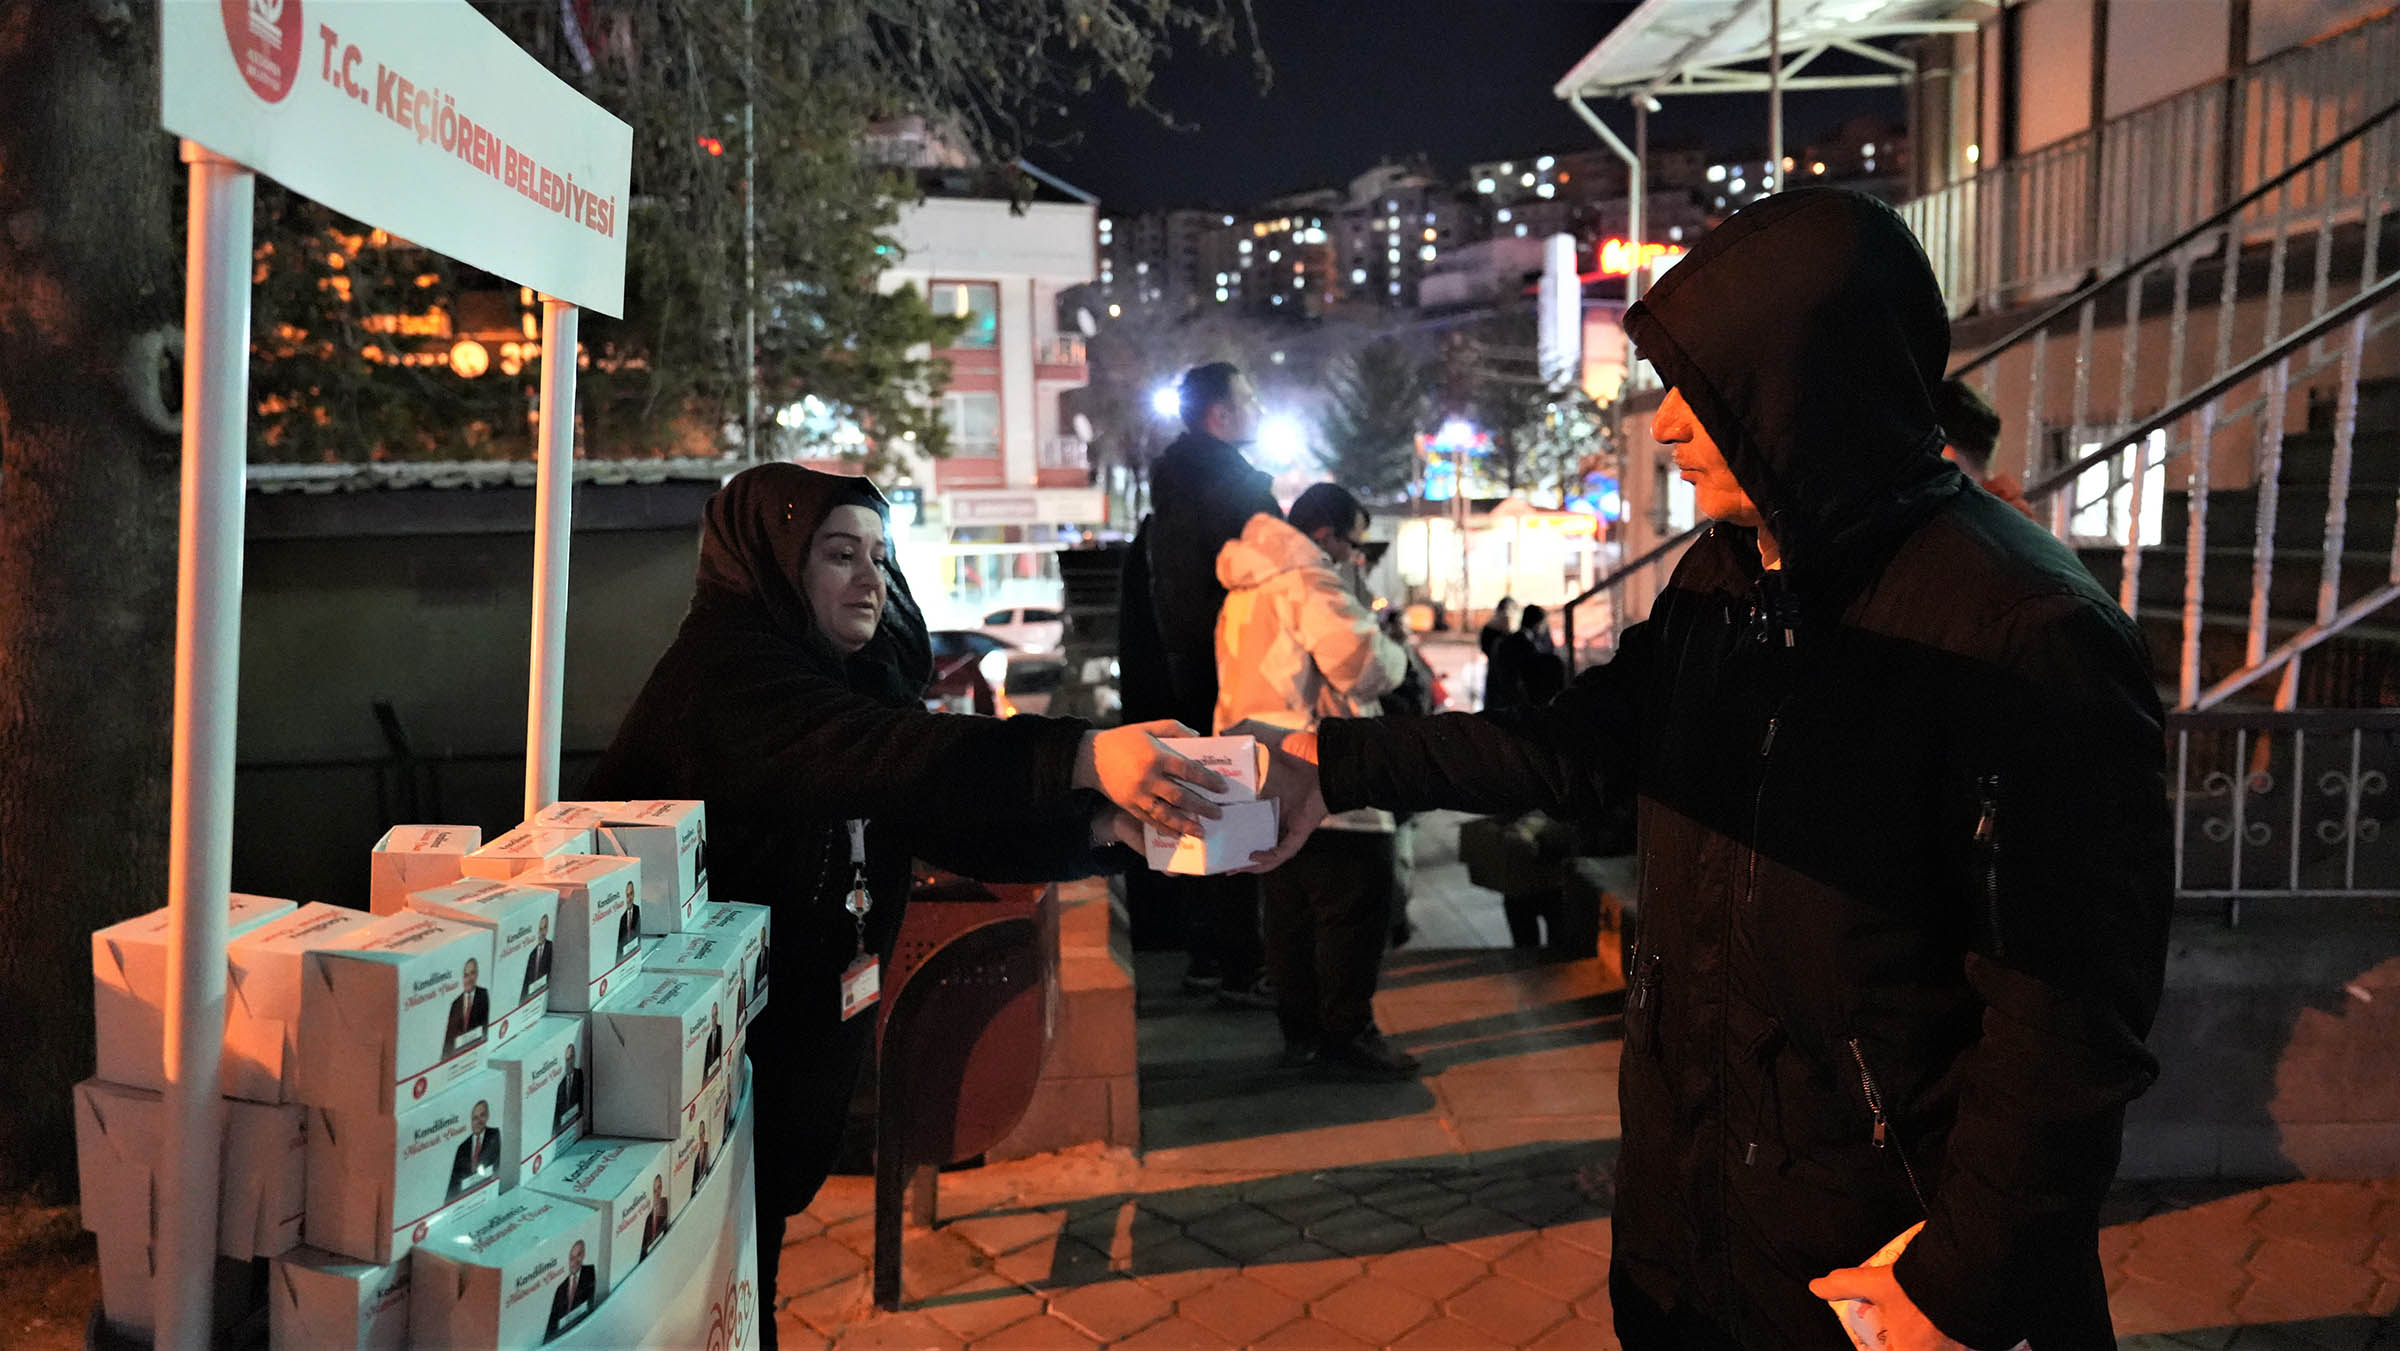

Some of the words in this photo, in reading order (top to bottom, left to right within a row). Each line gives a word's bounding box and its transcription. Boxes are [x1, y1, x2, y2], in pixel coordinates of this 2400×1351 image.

[319, 23, 369, 104] T.C.
[377, 63, 500, 180] KEÇİÖREN
[504, 143, 616, 238] BELEDİYESİ
